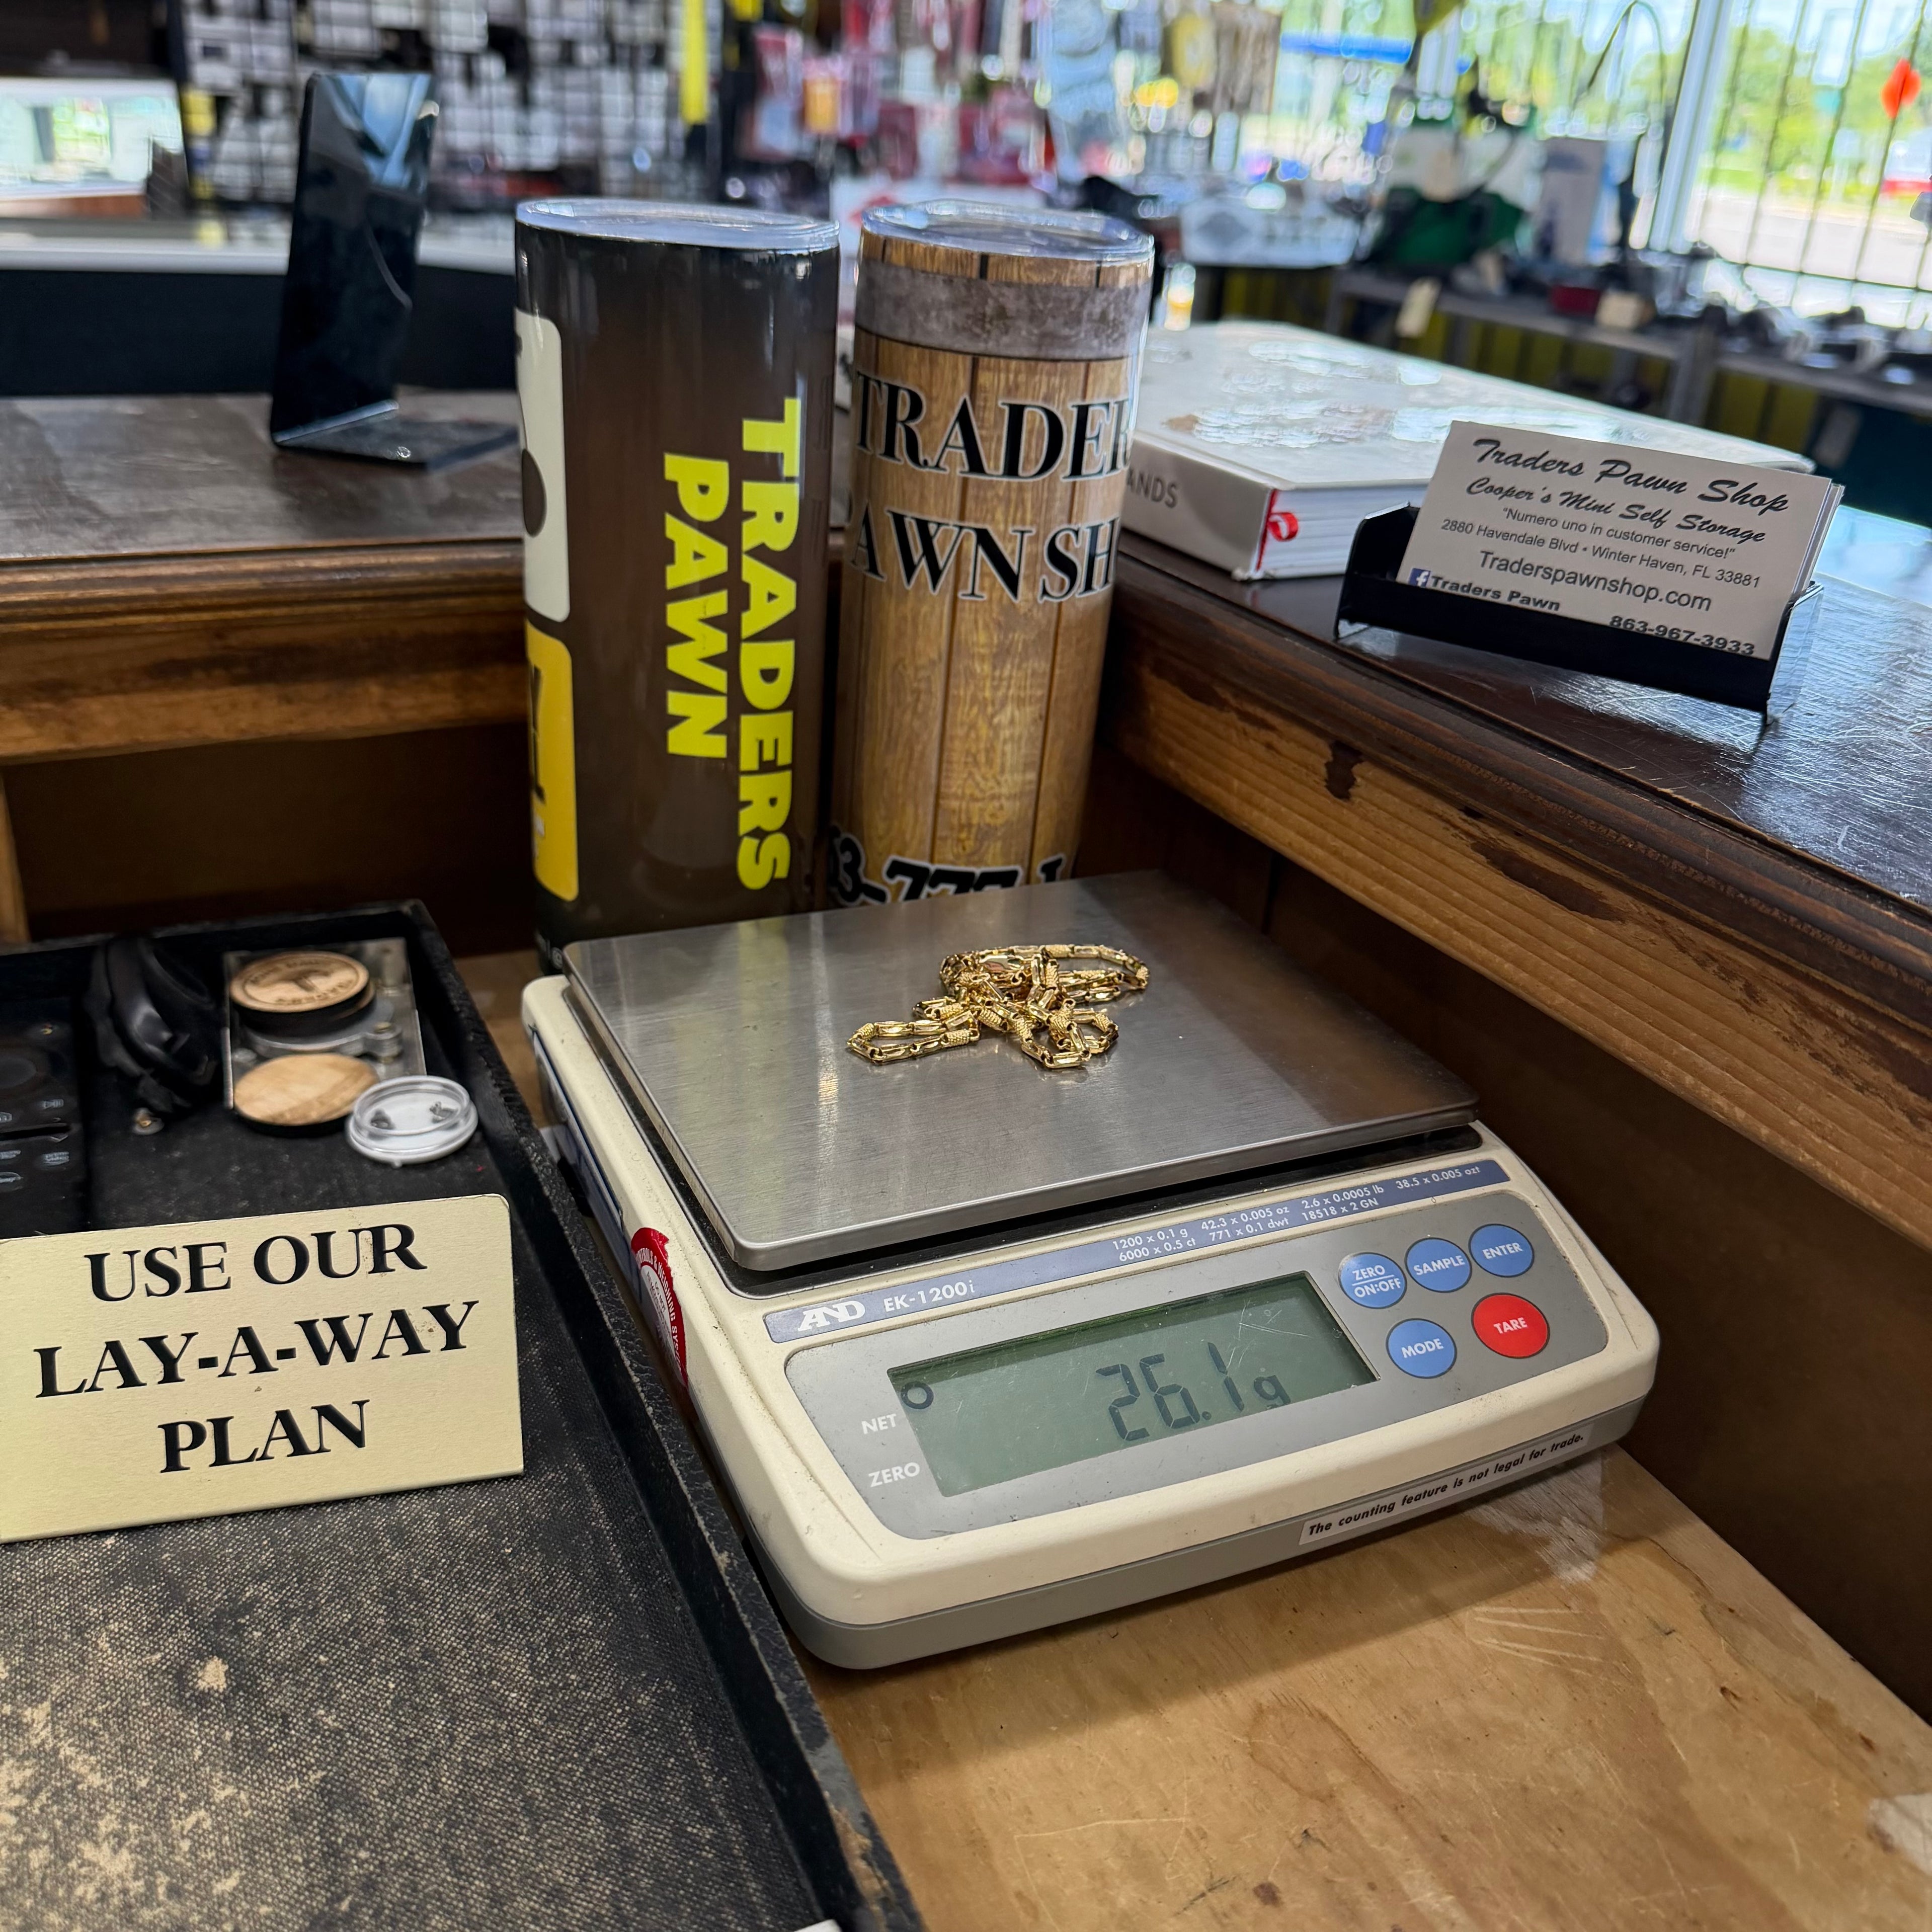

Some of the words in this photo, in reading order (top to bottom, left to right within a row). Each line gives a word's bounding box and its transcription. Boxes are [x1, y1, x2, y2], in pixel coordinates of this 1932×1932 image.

[1473, 439, 1584, 476] Traders
[1594, 459, 1689, 494] Pawn
[1697, 480, 1789, 516] Shop
[1466, 477, 1552, 503] Cooper's
[1559, 491, 1616, 514] Mini
[1619, 504, 1672, 529] Self
[1675, 514, 1765, 544] Storage
[849, 492, 1034, 602] AWN
[1561, 522, 1586, 533] uno
[1590, 522, 1602, 535] in
[1608, 527, 1670, 548] customer
[1441, 519, 1473, 534] 2880
[1476, 525, 1545, 547] Havendale
[1549, 538, 1578, 553] Blvd
[1592, 545, 1636, 564] Winter
[1639, 554, 1687, 576] Haven,
[1692, 565, 1710, 579] FL
[1715, 569, 1760, 588] 33881
[1480, 550, 1712, 611] Traderspawnshop.com
[665, 453, 729, 758] PAWN
[1431, 576, 1501, 599] Traders
[1507, 590, 1560, 612] Pawn
[737, 397, 801, 890] TRADERS
[1610, 615, 1755, 656] 863-967-3933
[1396, 1178, 1420, 1189] 38.5
[1432, 1170, 1462, 1182] 0.005
[1465, 1166, 1480, 1175] ozt
[1302, 1199, 1320, 1209] 2.6
[1333, 1187, 1371, 1202] 0.0005
[1373, 1184, 1384, 1194] lb
[1302, 1206, 1337, 1221] 18518
[1350, 1202, 1358, 1211] 2
[1360, 1197, 1379, 1209] GN
[1201, 1218, 1227, 1230] 42.3
[1240, 1209, 1273, 1223] 0.005
[1276, 1206, 1290, 1215] oz
[1209, 1230, 1231, 1242] 771
[1246, 1222, 1263, 1233] 0.1
[1268, 1217, 1289, 1229] dwt
[1112, 1236, 1143, 1250] 1200
[1157, 1228, 1176, 1241] 0.1
[1180, 1228, 1188, 1238] g
[1119, 1247, 1150, 1262] 6000
[1164, 1240, 1183, 1251] 0.5
[1187, 1238, 1196, 1247] ct
[1482, 1242, 1523, 1260] ENTER
[84, 1241, 231, 1302] USE
[254, 1223, 427, 1284] OUR
[1352, 1264, 1386, 1281] ZERO
[1413, 1255, 1465, 1275] SAMPLE
[884, 1280, 975, 1313] EK-1200i
[1354, 1277, 1401, 1298] ON:OFF
[1493, 1317, 1528, 1334] TARE
[34, 1300, 479, 1399] LAY-A-WAY
[1401, 1338, 1443, 1358] MODE
[158, 1399, 370, 1474] PLAN
[861, 1413, 897, 1434] NET
[869, 1462, 920, 1488] ZERO
[1309, 1522, 1332, 1535] The
[1338, 1501, 1396, 1526] counting
[1401, 1484, 1448, 1506] feature
[1453, 1479, 1464, 1488] is
[1469, 1468, 1489, 1483] not
[1493, 1453, 1525, 1474] legal
[1529, 1448, 1547, 1461] for
[1550, 1433, 1584, 1452] trade.
